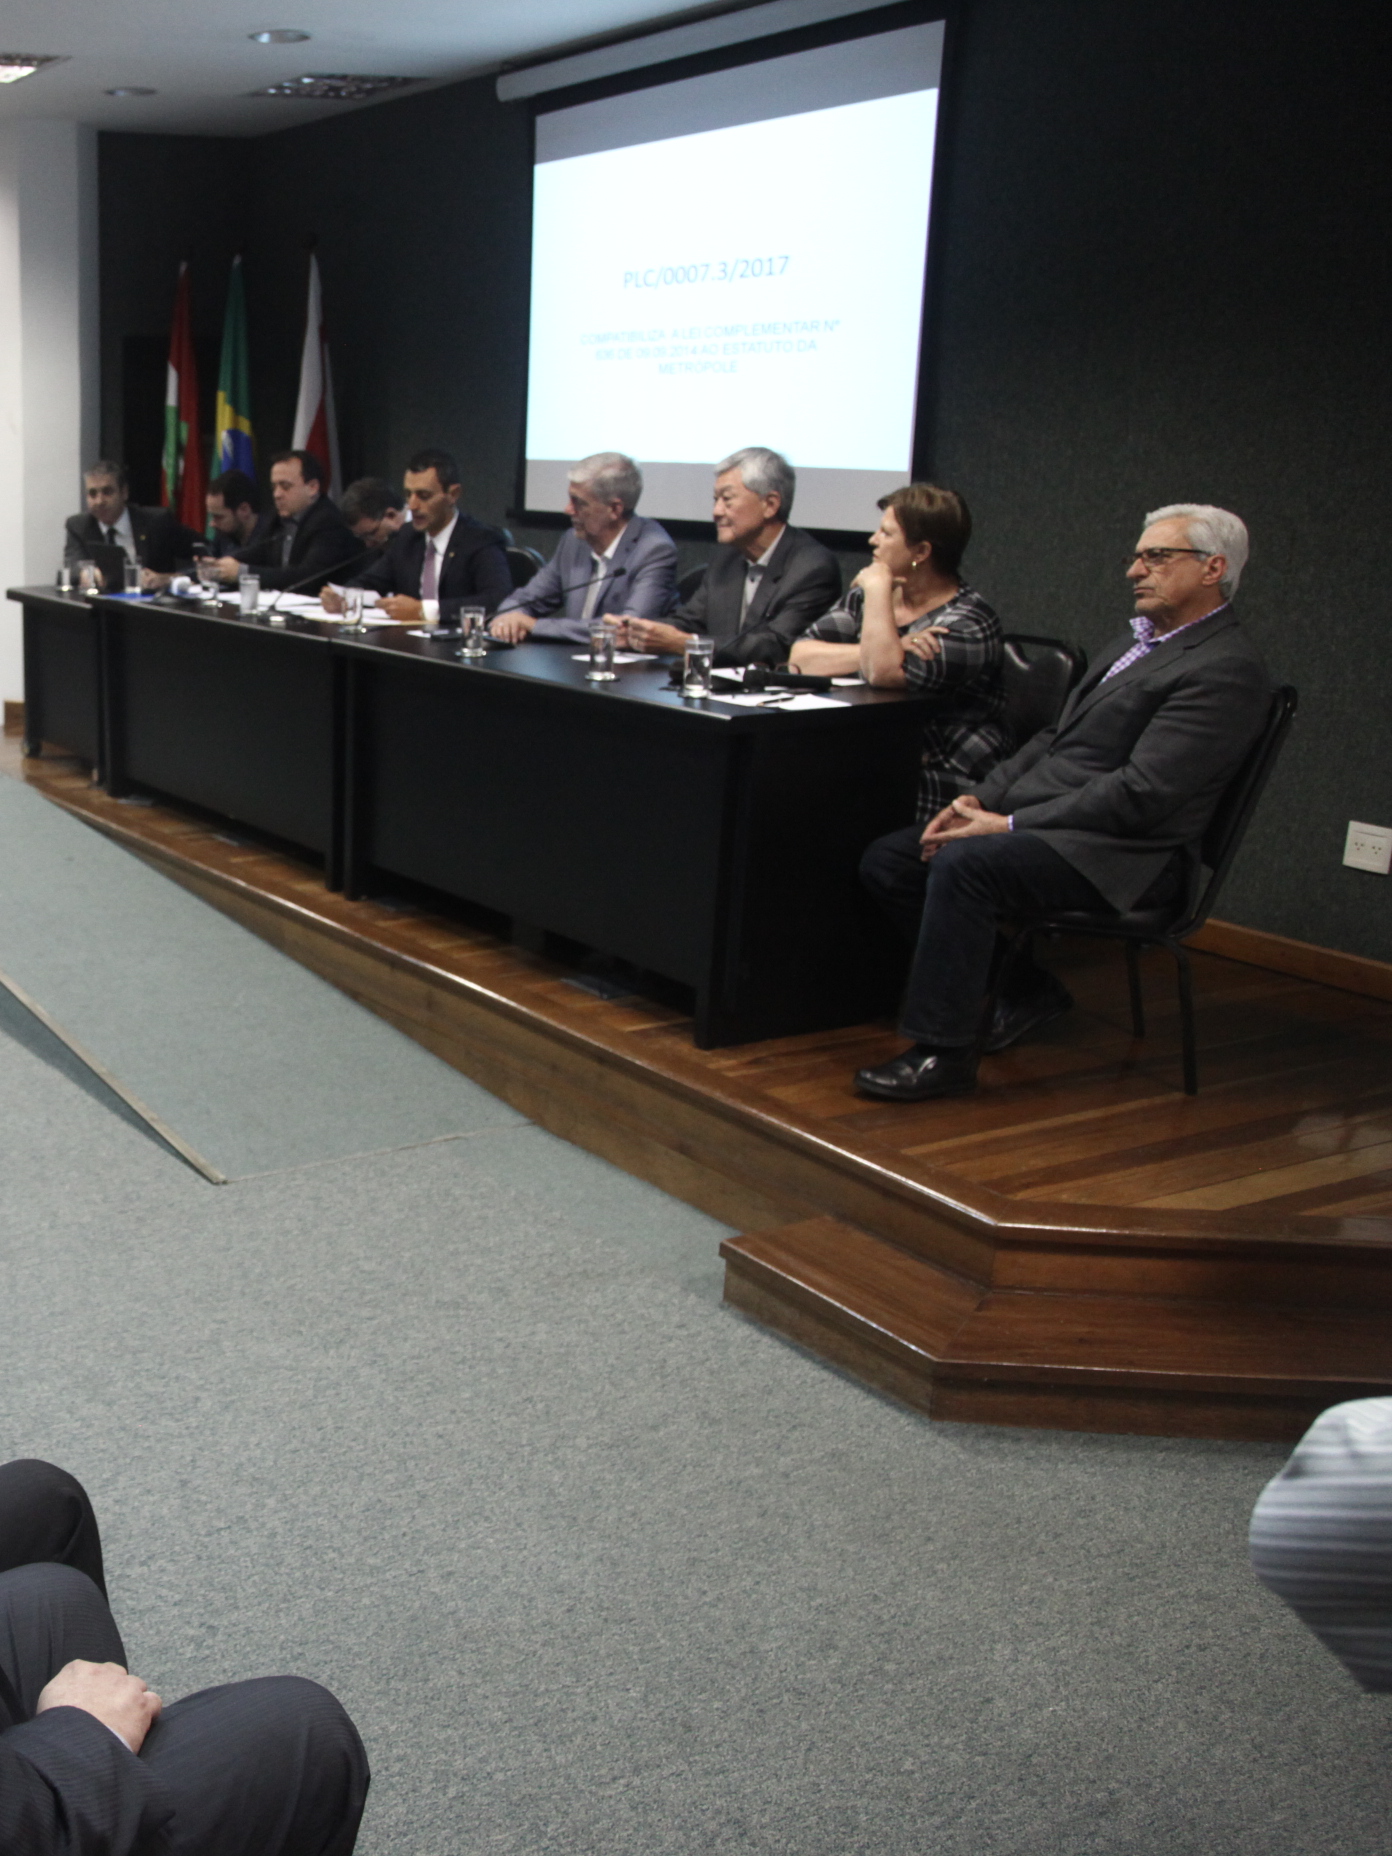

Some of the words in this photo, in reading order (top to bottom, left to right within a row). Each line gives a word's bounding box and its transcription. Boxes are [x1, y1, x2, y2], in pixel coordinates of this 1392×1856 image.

[623, 254, 791, 290] PLC/0007.3/2017
[703, 319, 821, 338] COMPLEMENTAR
[722, 339, 795, 355] ESTATUTO
[797, 338, 818, 353] DA
